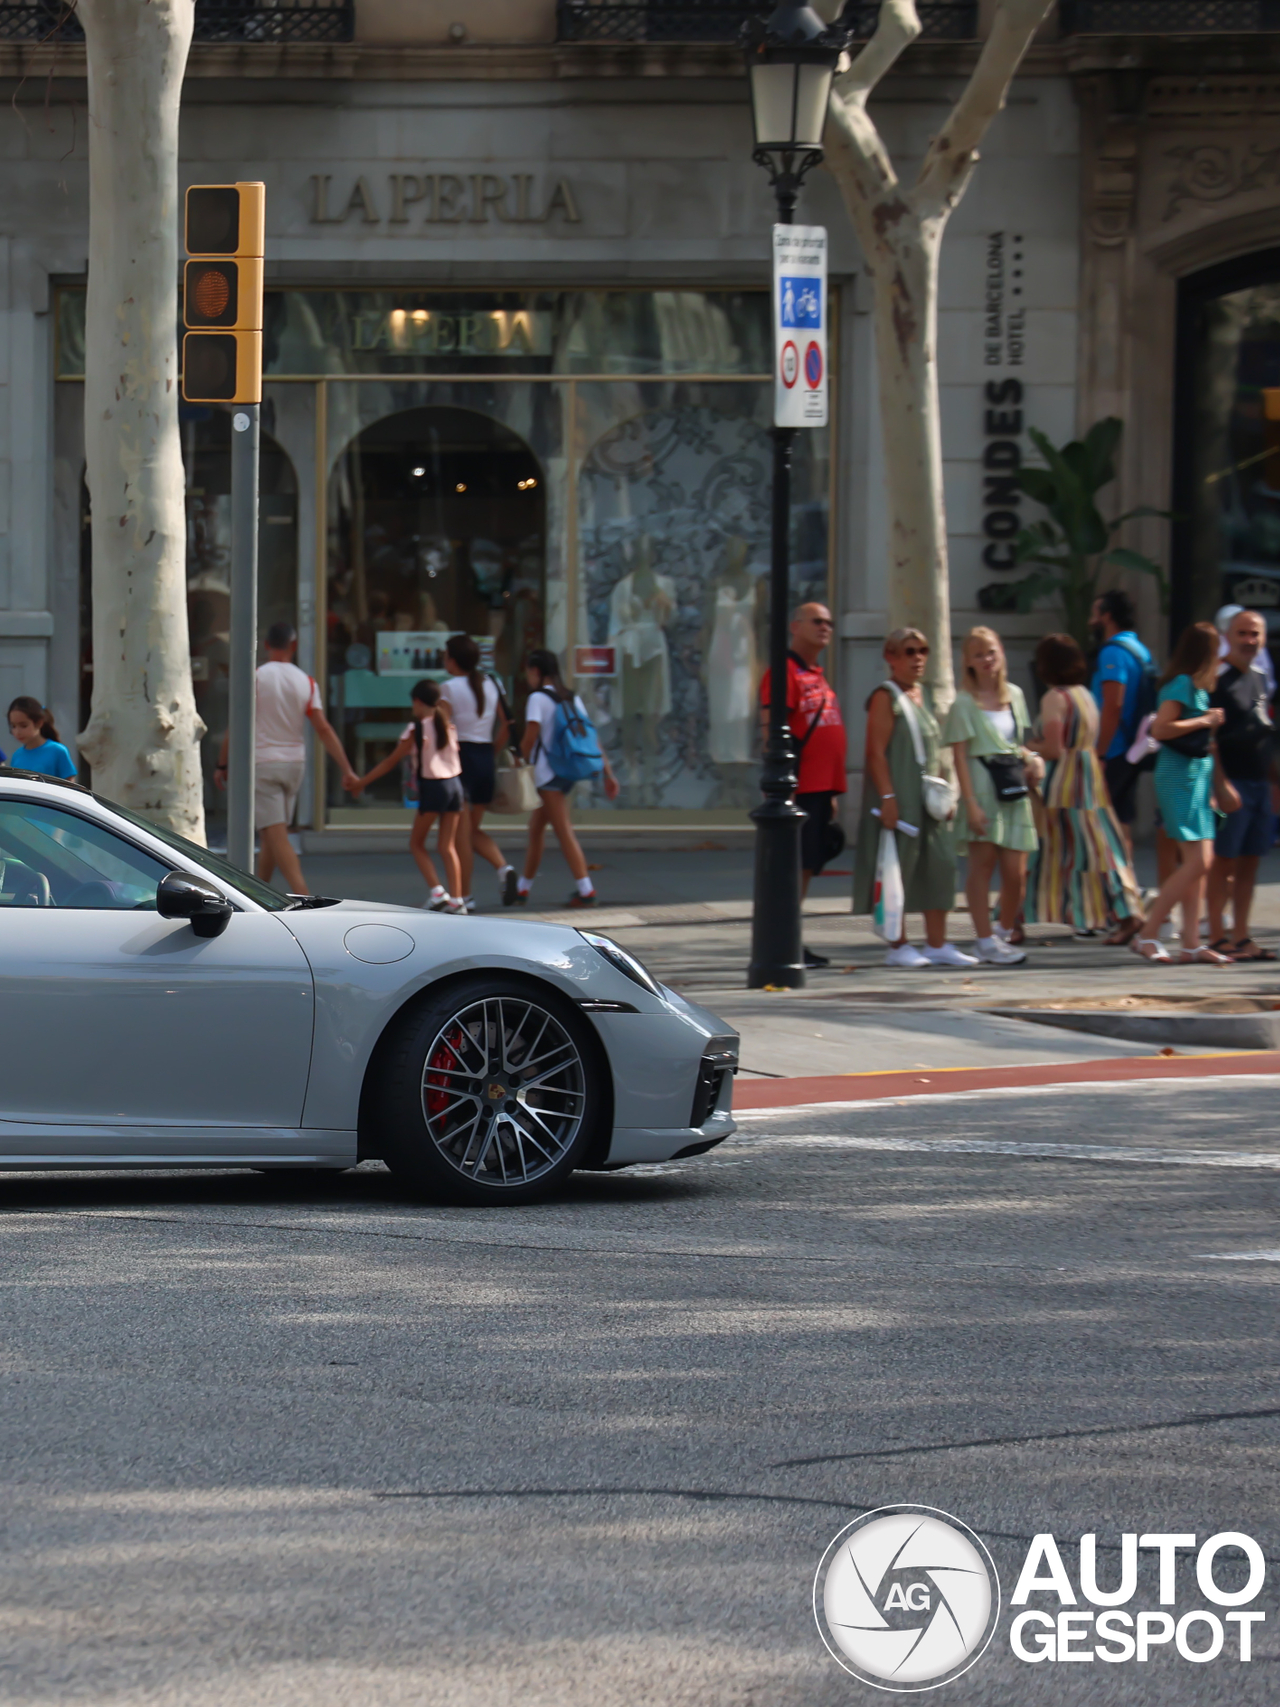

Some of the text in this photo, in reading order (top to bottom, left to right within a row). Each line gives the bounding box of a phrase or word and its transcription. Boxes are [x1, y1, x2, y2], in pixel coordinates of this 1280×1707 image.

[309, 174, 582, 223] LA PERLA
[984, 231, 1004, 366] DE BARCELONA
[1007, 308, 1025, 366] HOTEL
[982, 378, 1023, 571] CONDES
